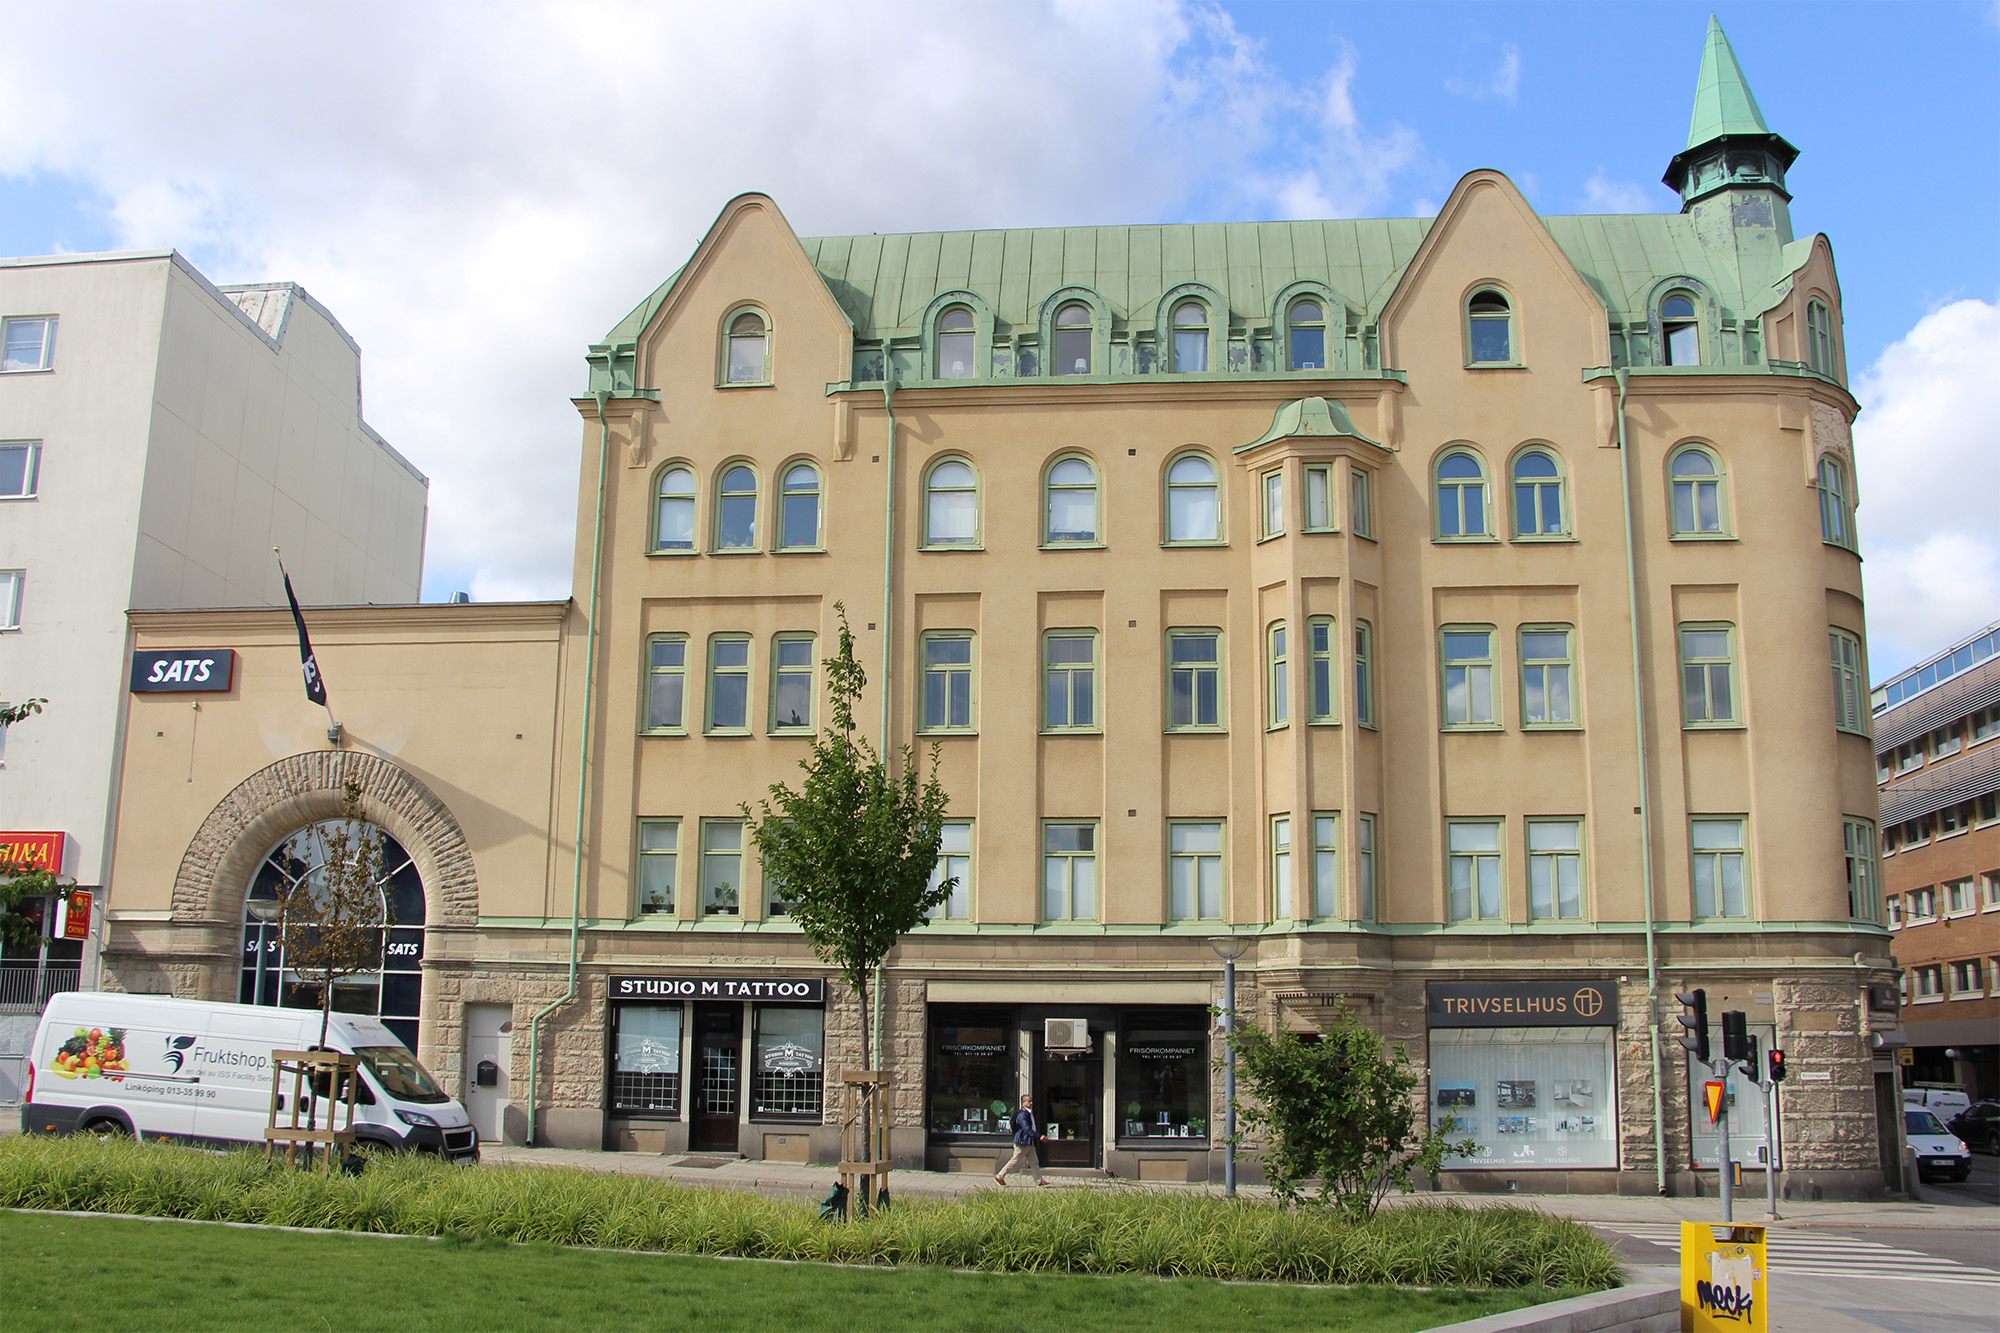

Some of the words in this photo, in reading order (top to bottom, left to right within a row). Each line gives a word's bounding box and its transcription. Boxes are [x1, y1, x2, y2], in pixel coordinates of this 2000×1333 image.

[147, 658, 215, 683] SATS
[246, 940, 277, 953] SAS
[387, 943, 419, 956] SATS
[619, 979, 696, 995] STUDIO
[700, 981, 719, 996] M
[724, 982, 811, 997] TATTOO
[1321, 997, 1334, 1007] 10
[1442, 997, 1568, 1014] TRIVSELHUS
[642, 1046, 651, 1054] M
[764, 1051, 784, 1059] STUDIO
[784, 1049, 794, 1057] M
[795, 1051, 814, 1060] TATTOO
[941, 1044, 1007, 1052] FRISÖRKOMPANIET
[217, 1070, 231, 1079] ISS
[231, 1072, 256, 1082] Facility
[256, 1073, 287, 1084] Serves
[125, 1083, 165, 1095] Linköping
[166, 1086, 193, 1096] 013-35
[194, 1088, 205, 1097] 99
[206, 1090, 217, 1099] 90
